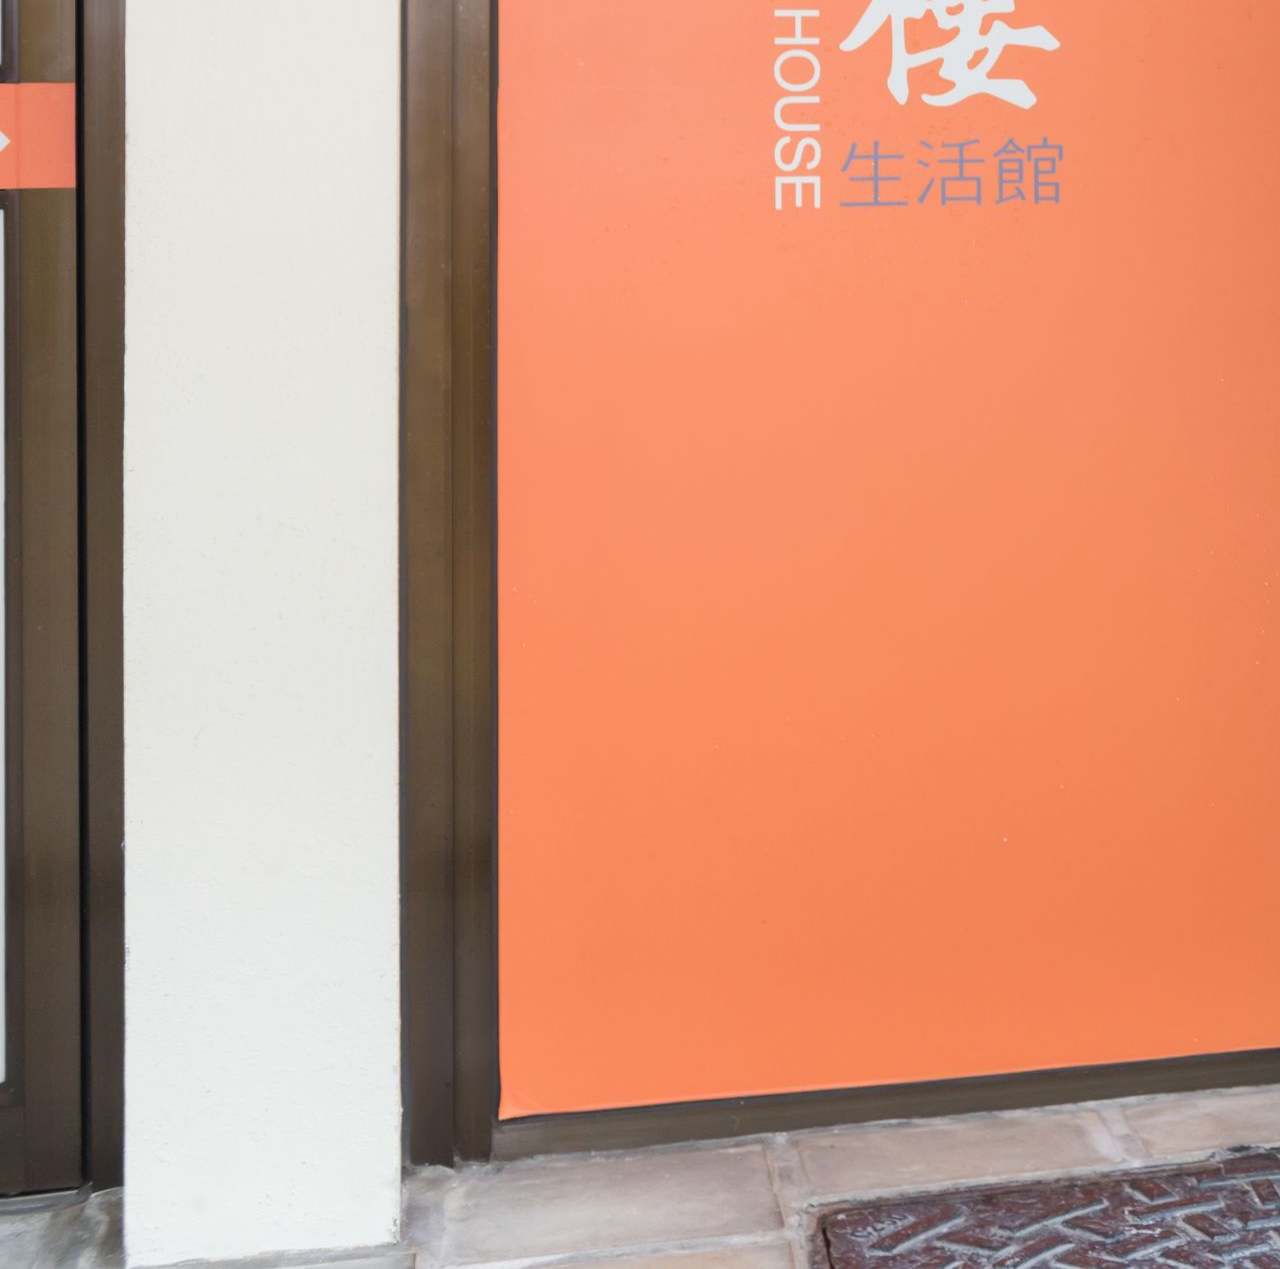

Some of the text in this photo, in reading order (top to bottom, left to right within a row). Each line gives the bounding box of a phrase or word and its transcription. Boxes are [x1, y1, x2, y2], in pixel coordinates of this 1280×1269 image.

[773, 9, 821, 210] HOUSE
[840, 138, 1064, 207] 生活館
